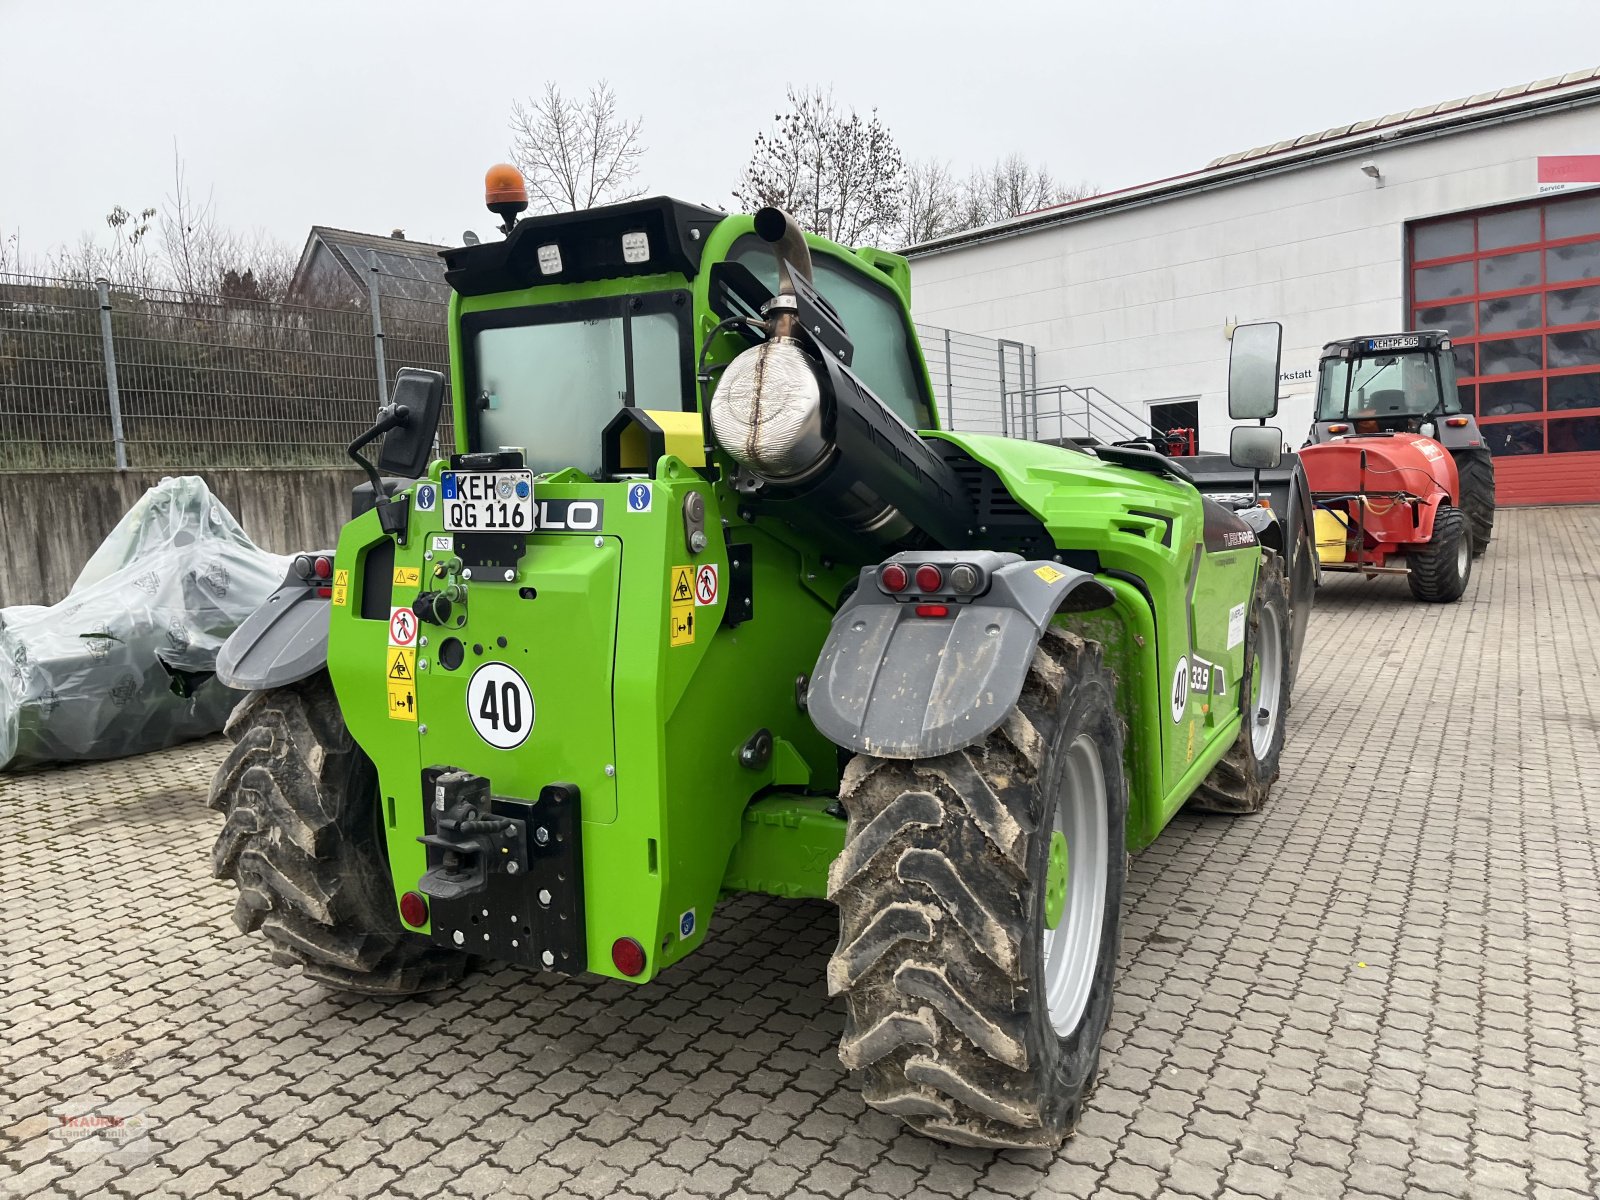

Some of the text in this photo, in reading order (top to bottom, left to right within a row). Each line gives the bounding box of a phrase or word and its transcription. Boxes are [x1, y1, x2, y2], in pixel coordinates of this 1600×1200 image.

[1540, 184, 1565, 192] Service
[1373, 337, 1419, 349] KEH PF 505
[447, 489, 453, 498] D
[457, 475, 497, 501] KEH
[451, 503, 525, 528] QG 116
[534, 501, 599, 530] LO
[1174, 668, 1187, 710] 40
[479, 680, 522, 733] 40
